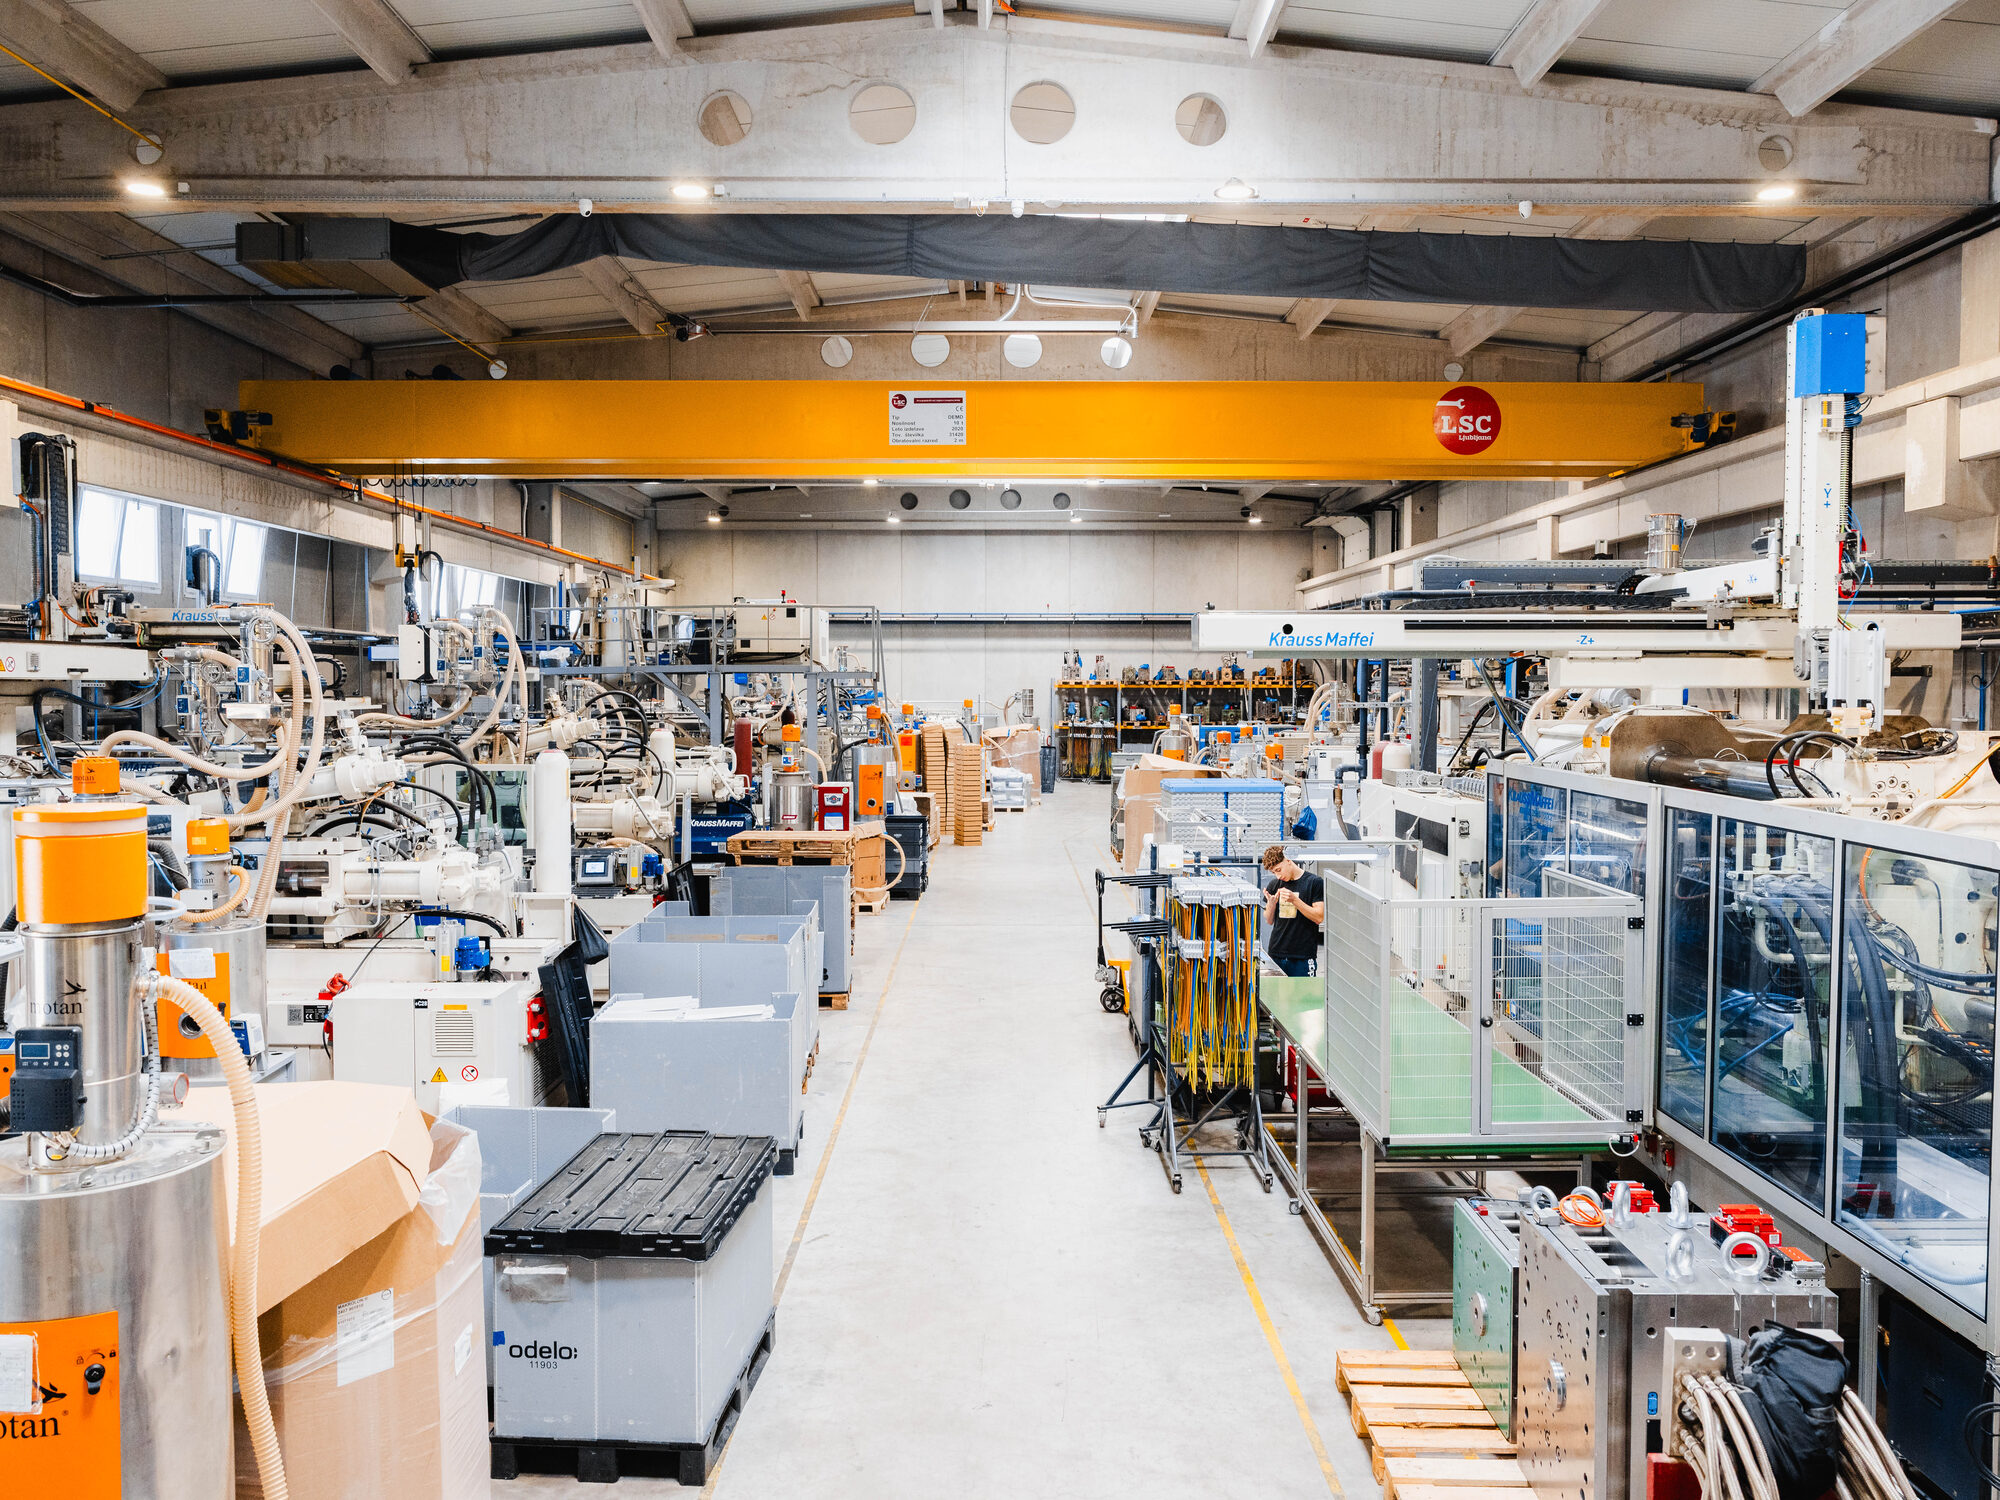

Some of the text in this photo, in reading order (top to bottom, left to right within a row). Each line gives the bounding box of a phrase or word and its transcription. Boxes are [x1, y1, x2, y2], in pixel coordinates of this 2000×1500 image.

[1441, 415, 1492, 434] LSC
[1458, 434, 1492, 442] Ljubljana
[529, 1361, 558, 1369] 11903
